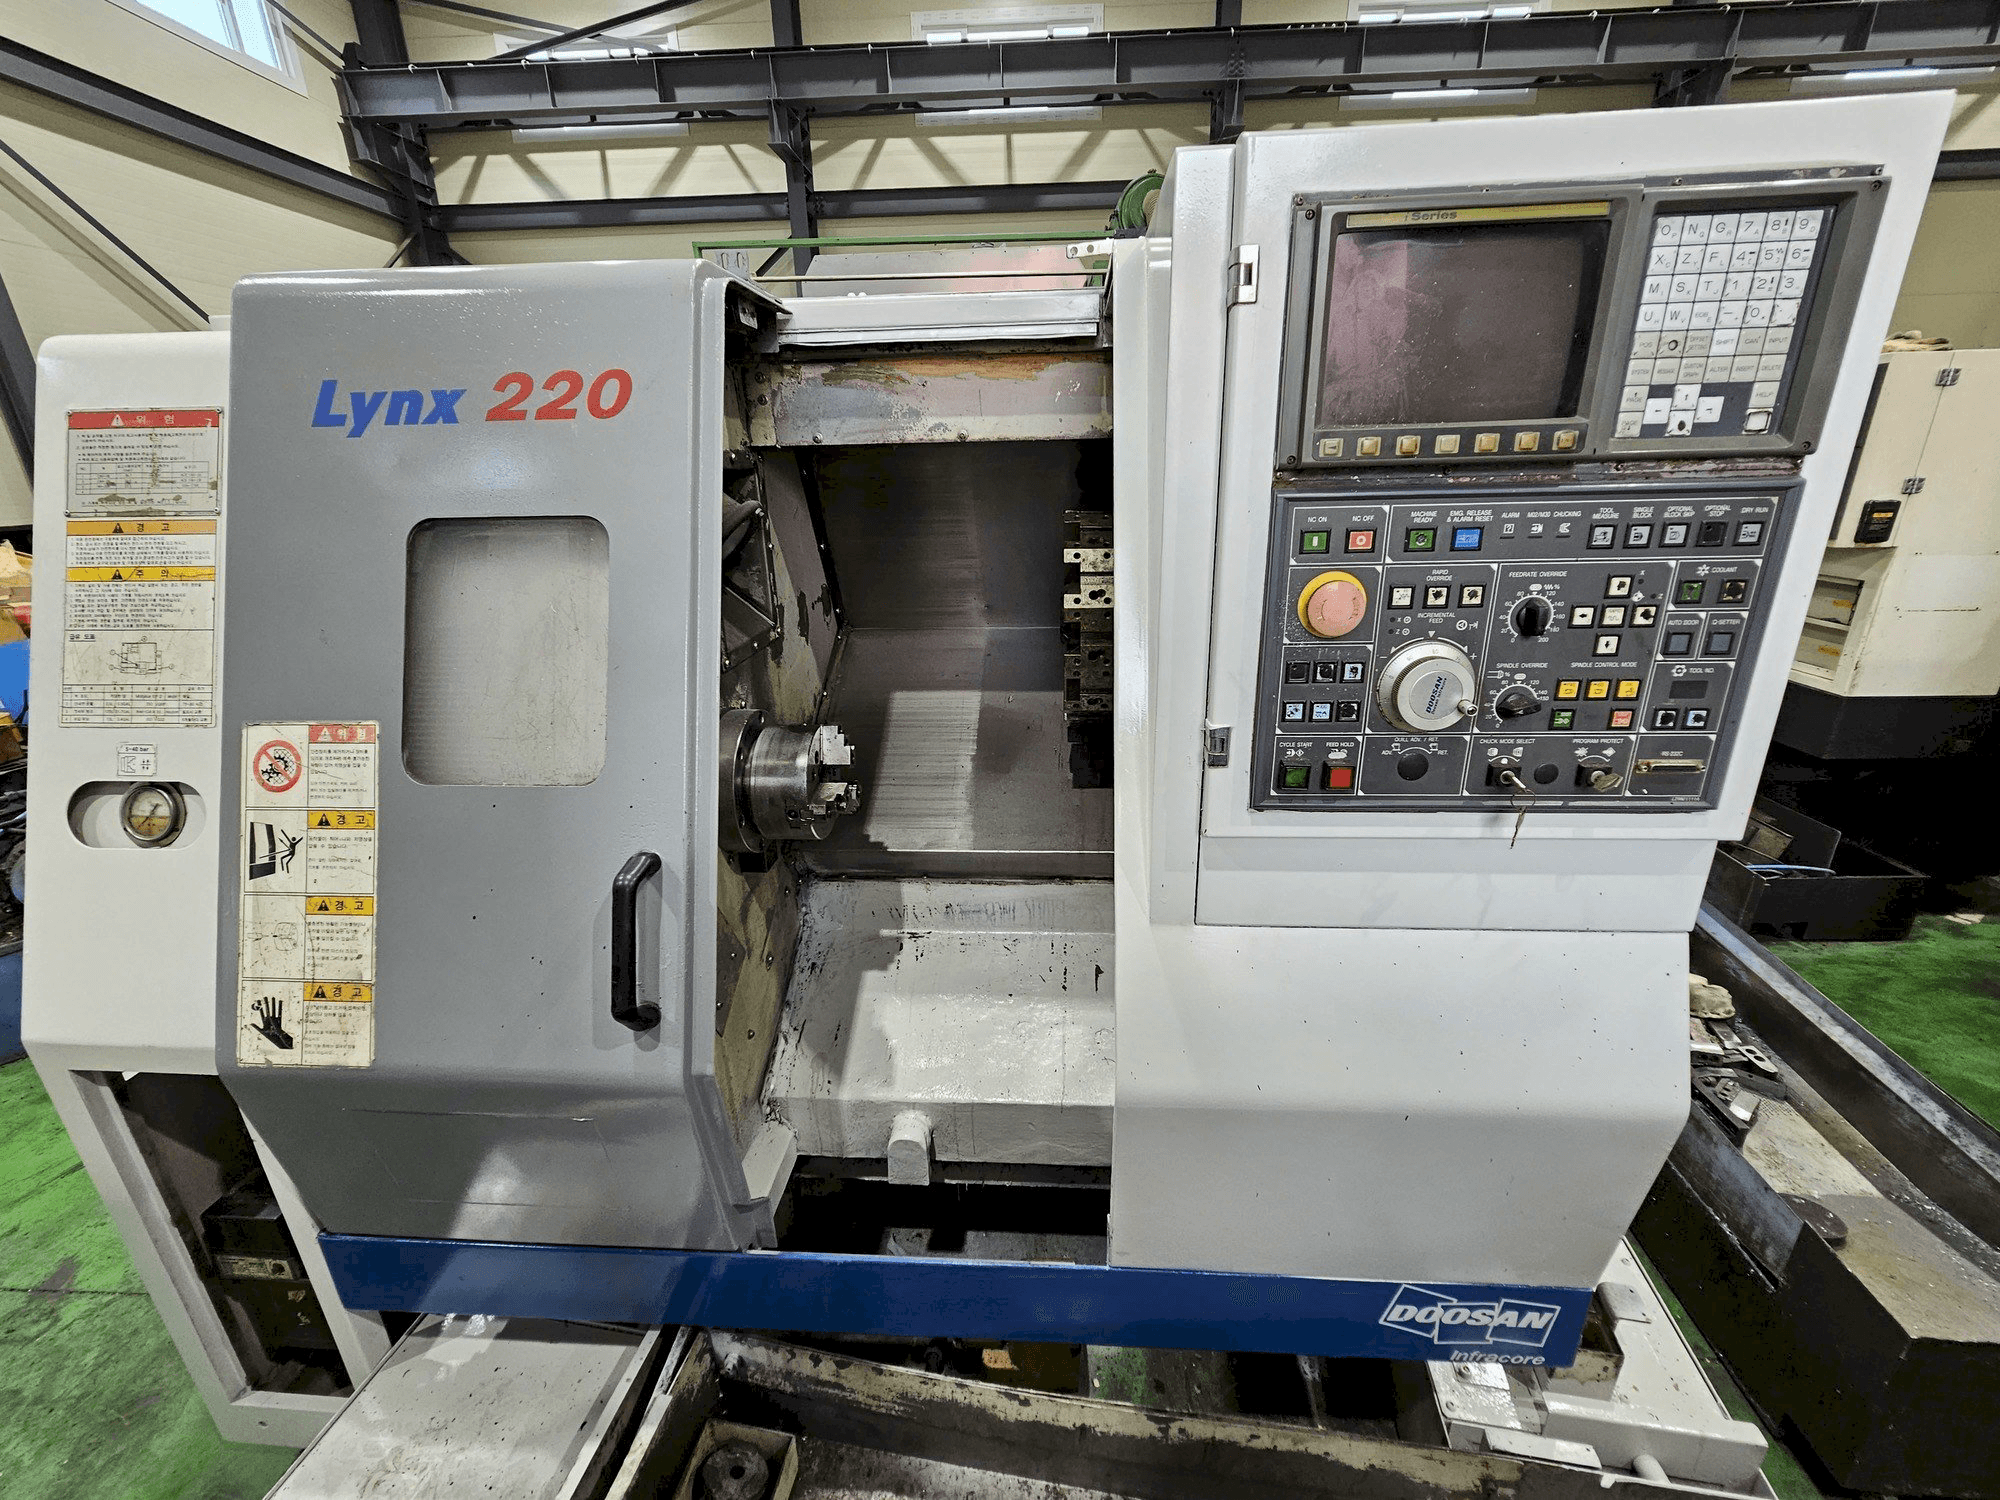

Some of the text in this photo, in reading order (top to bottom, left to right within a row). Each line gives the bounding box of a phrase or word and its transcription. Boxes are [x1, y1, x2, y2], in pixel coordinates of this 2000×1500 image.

[1411, 211, 1457, 221] Series
[1688, 223, 1698, 234] N
[1715, 222, 1726, 233] G
[1745, 221, 1754, 232] 7
[1771, 220, 1781, 230] 8
[1799, 219, 1809, 229] 9
[1682, 253, 1692, 264] Z
[1709, 252, 1719, 262] F
[1736, 250, 1746, 261] 4
[1764, 249, 1774, 260] 5
[1792, 248, 1801, 259] 6
[1654, 254, 1664, 265] X
[1648, 283, 1659, 293] M
[1676, 282, 1685, 292] S
[1704, 280, 1713, 291] T
[1732, 280, 1738, 290] 1
[1757, 278, 1767, 289] 2
[1784, 277, 1794, 288] 3
[1644, 311, 1653, 321] U
[1670, 310, 1681, 321] W
[1715, 338, 1735, 346] SHIFT
[1709, 365, 1729, 373] ALTER
[311, 368, 634, 439] Lynx 220
[1426, 676, 1443, 714] DOOSAN
[1386, 1304, 1554, 1329] DOOSAN
[1449, 1349, 1546, 1365] Infracore
